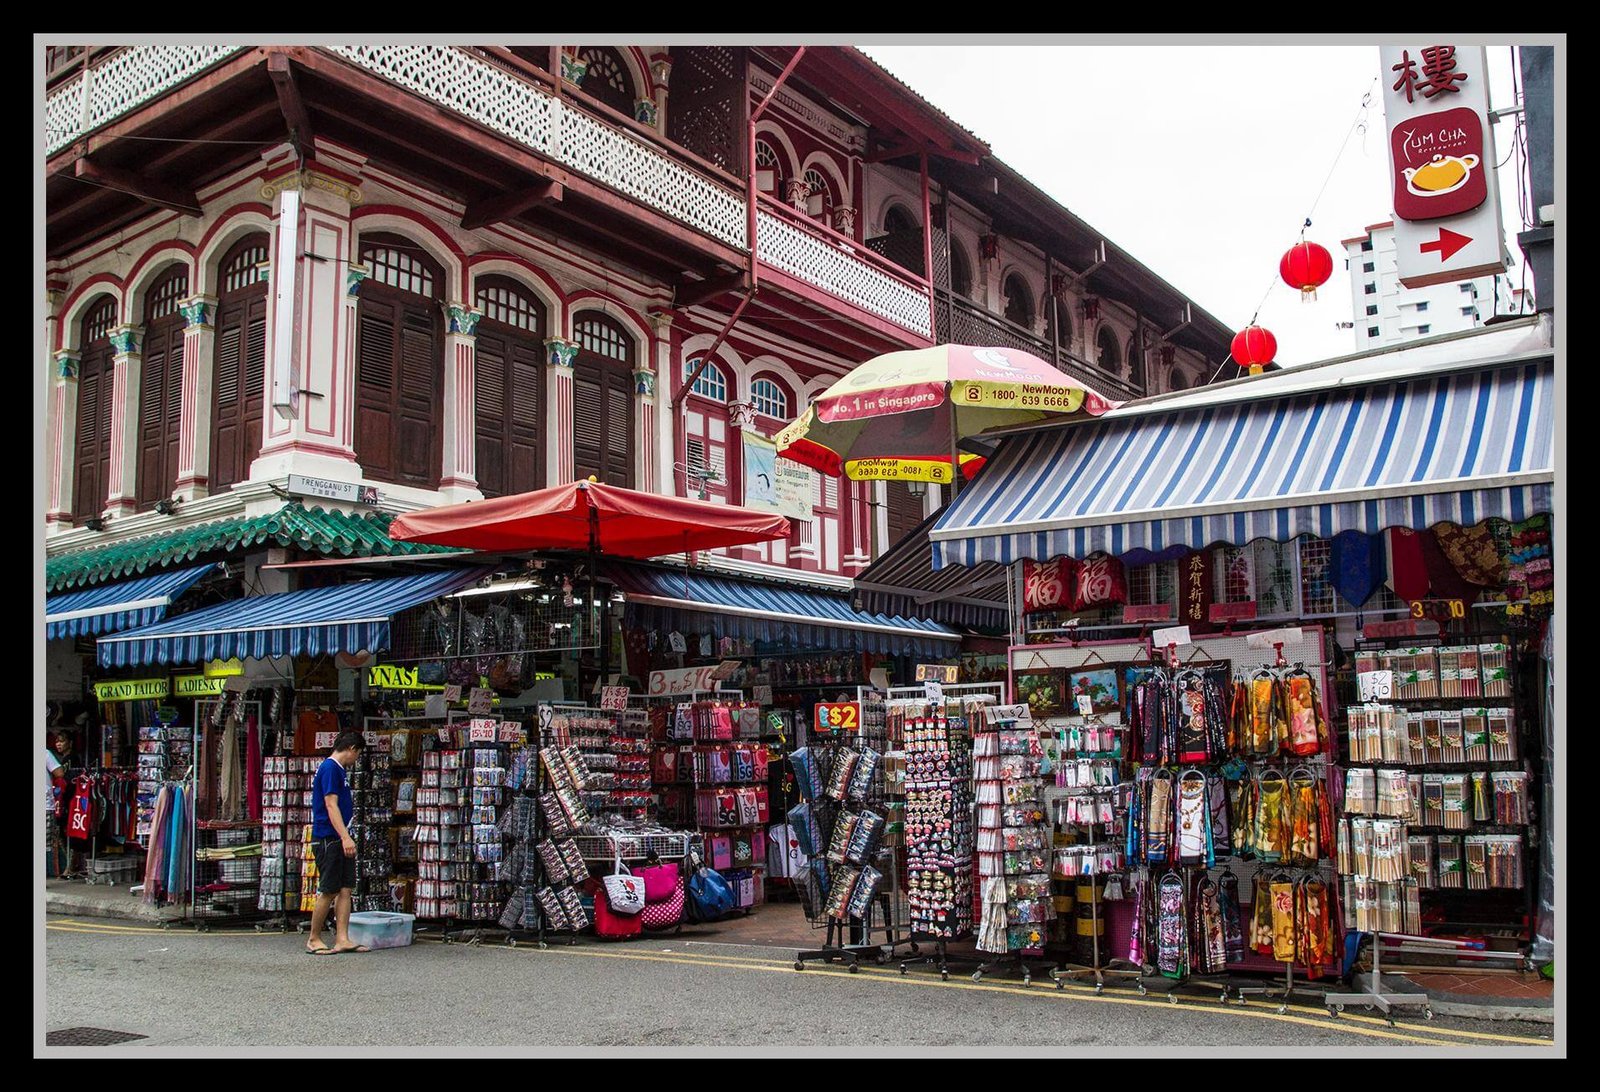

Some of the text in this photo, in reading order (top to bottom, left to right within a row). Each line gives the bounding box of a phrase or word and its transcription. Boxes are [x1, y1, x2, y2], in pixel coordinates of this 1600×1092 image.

[1402, 128, 1467, 162] YUM CHA
[975, 368, 1042, 380] NewMoon
[1022, 384, 1071, 396] NewMoon
[832, 393, 935, 414] No. 1 in Singapore
[1021, 396, 1069, 407] 639 6666
[301, 478, 342, 491] TRENGGANU
[344, 485, 352, 493] ST
[1026, 559, 1062, 607] 福
[1078, 555, 1112, 604] 福
[1411, 601, 1424, 618] 3
[1449, 600, 1465, 618] 10
[369, 667, 418, 686] YNAS
[651, 671, 667, 694] 3
[917, 666, 926, 680] 3
[946, 667, 958, 683] 10
[1371, 671, 1388, 685] $2
[100, 681, 168, 698] GRAND TAILOR
[540, 707, 553, 730] $2
[830, 705, 857, 728] $2
[677, 720, 692, 732] SG
[740, 766, 752, 779] SG
[73, 795, 81, 812] I
[744, 806, 757, 818] SG
[719, 809, 736, 824] SG
